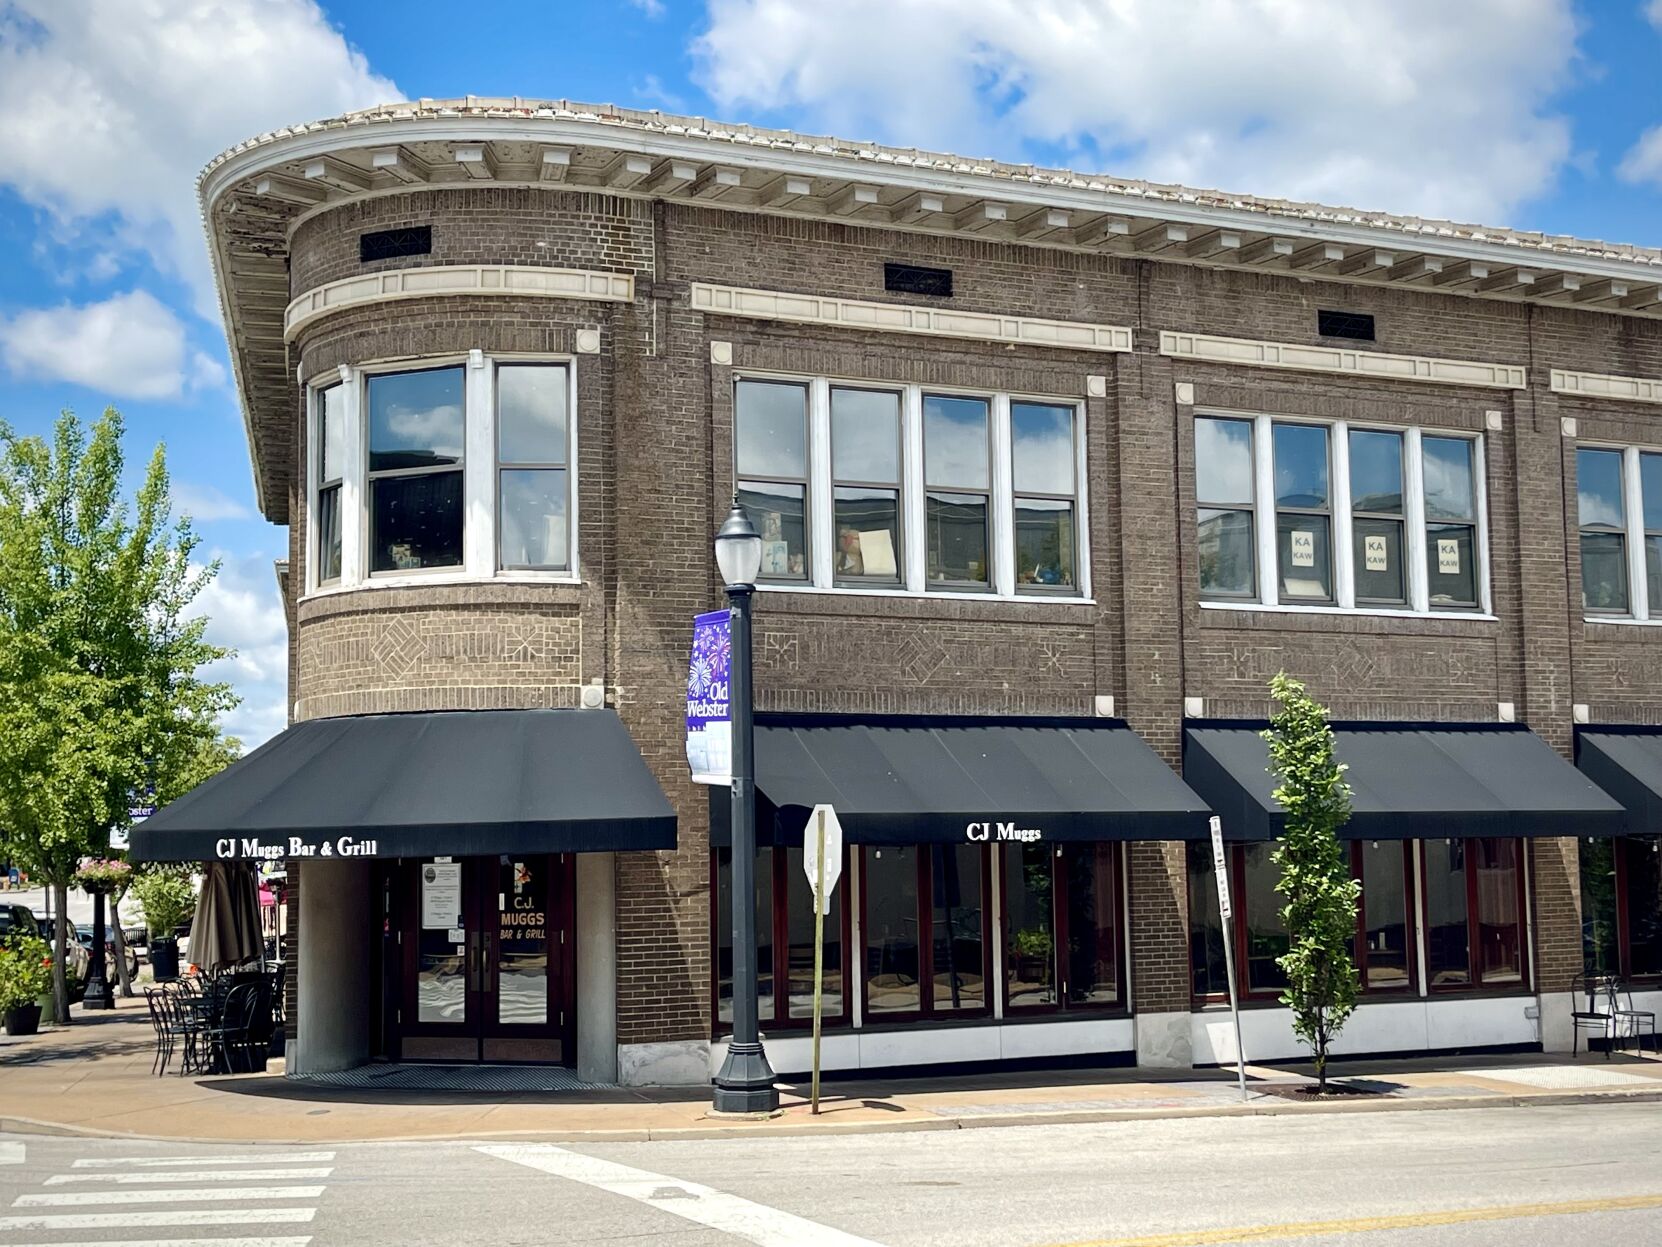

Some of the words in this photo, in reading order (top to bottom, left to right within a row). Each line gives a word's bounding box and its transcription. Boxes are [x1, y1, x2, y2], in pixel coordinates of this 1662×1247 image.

[1294, 536, 1311, 547] KA
[1368, 541, 1384, 551] KA
[1441, 545, 1456, 554] KA
[1293, 551, 1313, 560] KAW
[1366, 556, 1386, 565] KAW
[1439, 559, 1458, 567] KAW
[710, 681, 728, 700] Old
[687, 699, 729, 717] Webster
[966, 822, 990, 841] CJ
[995, 822, 1042, 842] Muggs
[216, 838, 236, 858] CJ
[241, 838, 285, 859] Muggs
[288, 836, 316, 857] Bar
[320, 841, 332, 856] &
[337, 836, 377, 856] Grill
[514, 896, 535, 909] C.J.
[501, 912, 545, 926] MUGGS
[500, 929, 513, 939] BAR
[516, 929, 522, 939] &
[525, 929, 546, 939] GRILL
